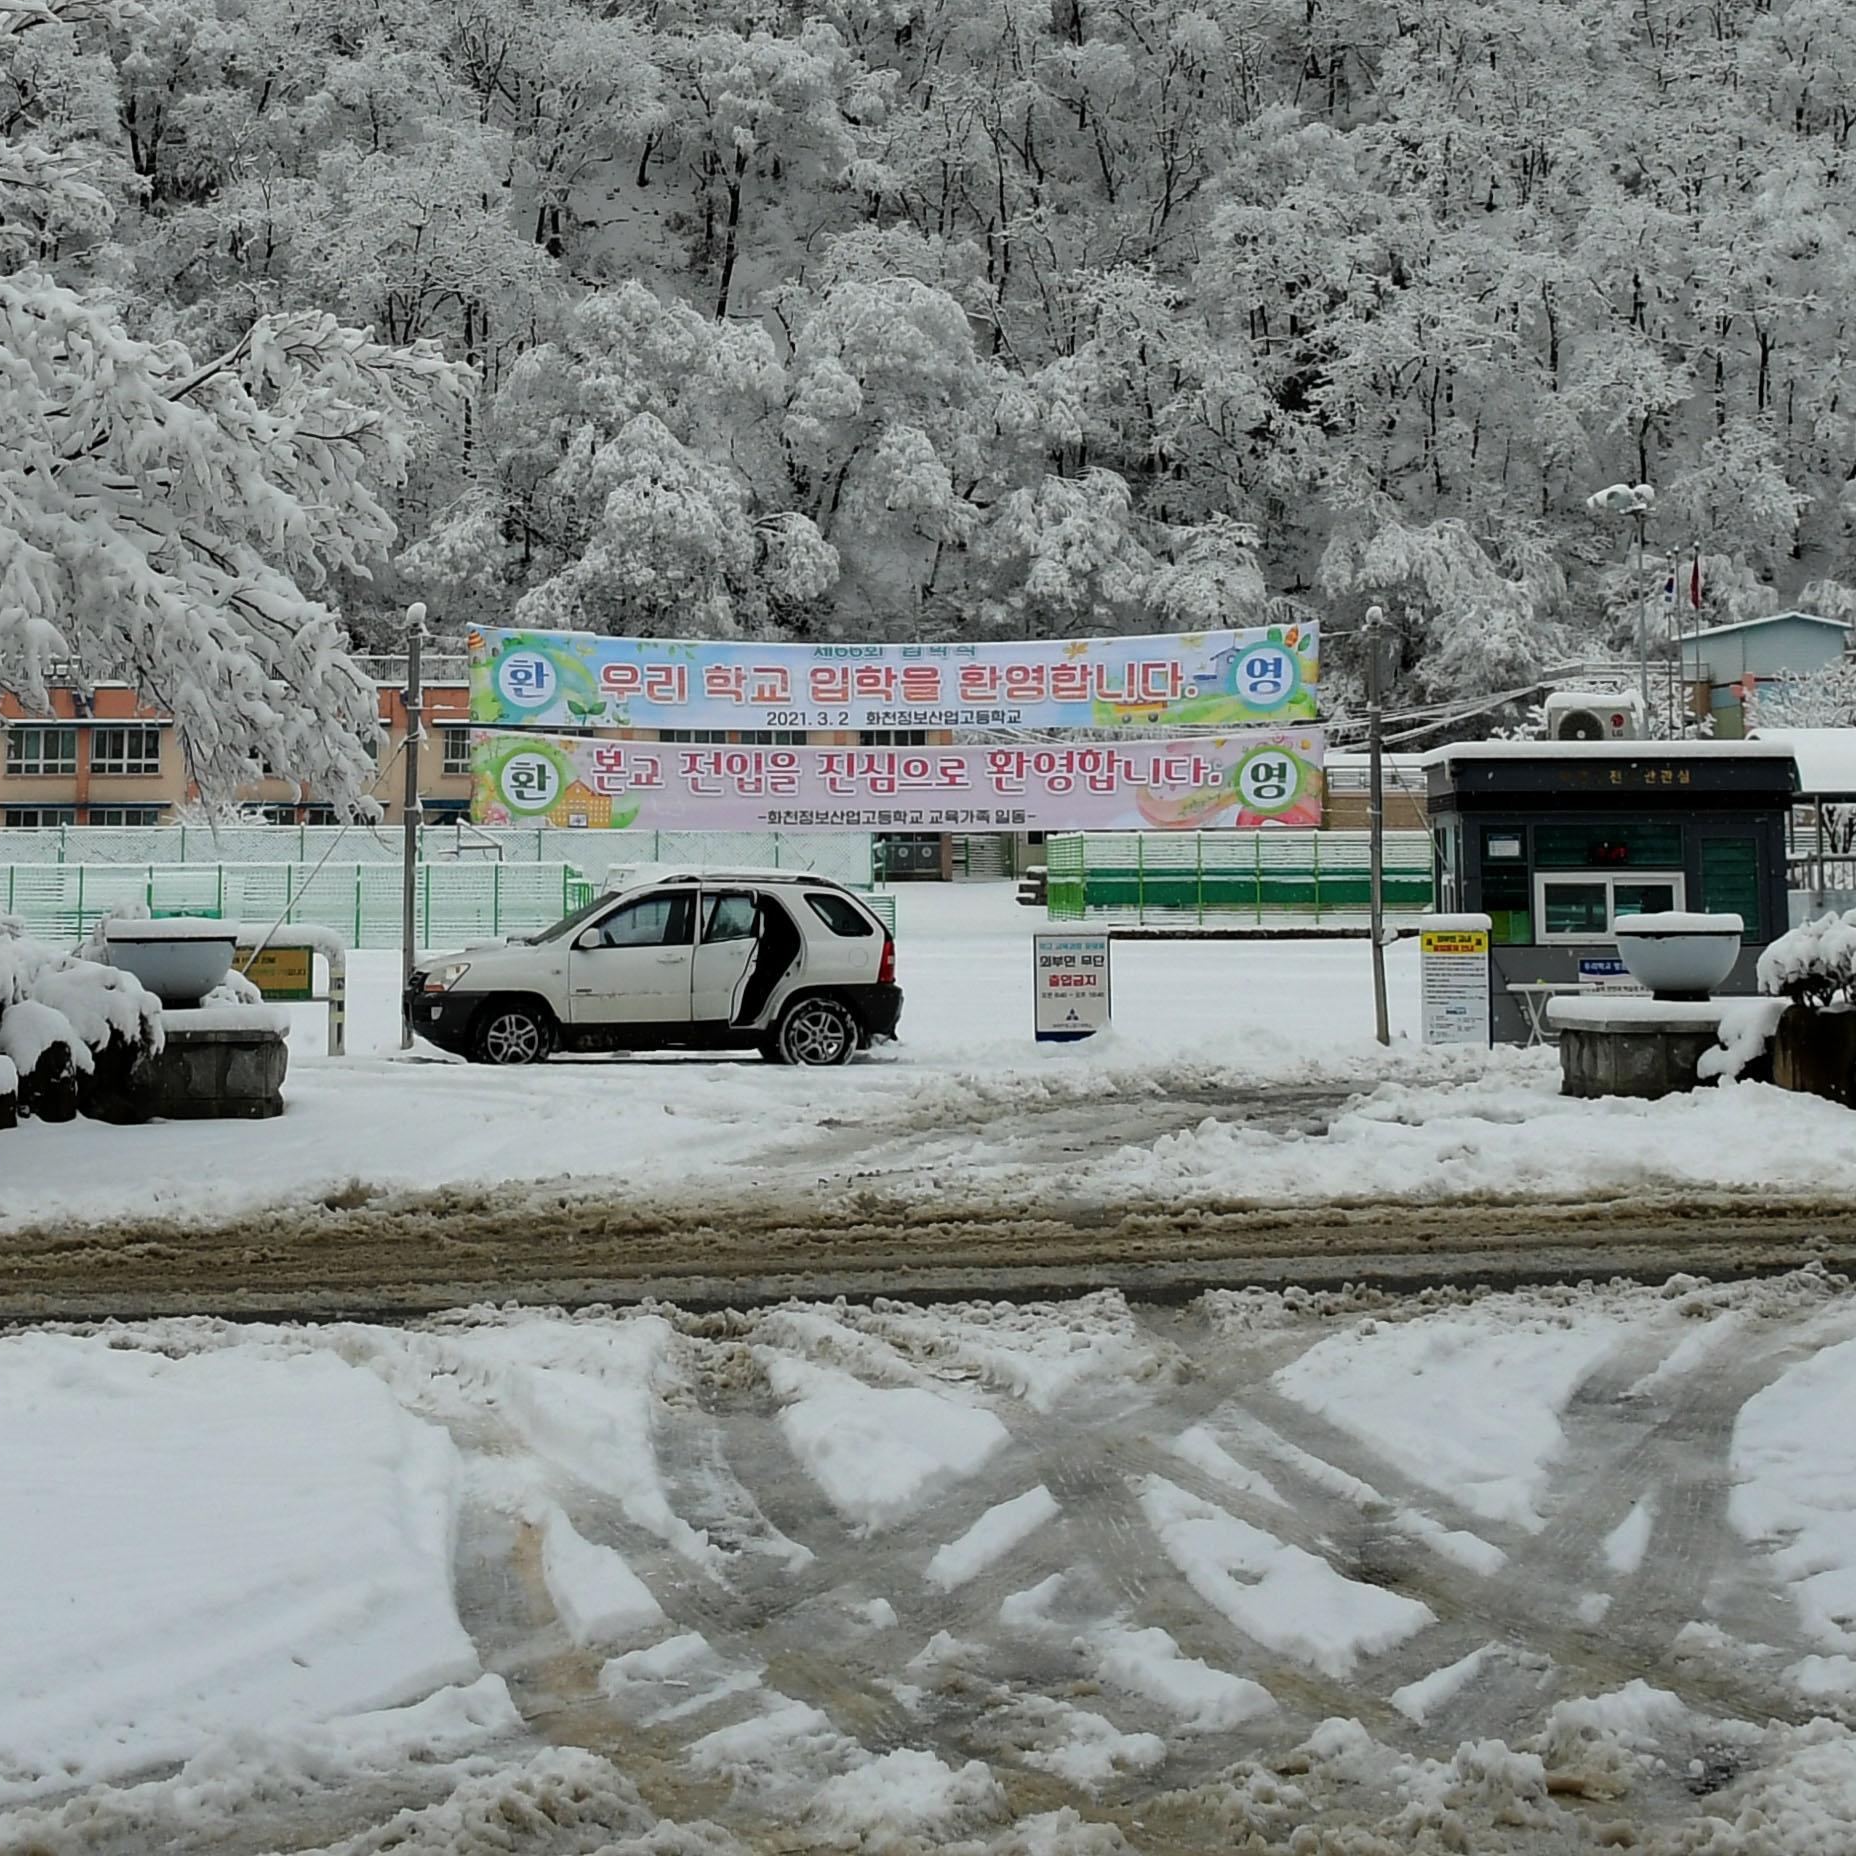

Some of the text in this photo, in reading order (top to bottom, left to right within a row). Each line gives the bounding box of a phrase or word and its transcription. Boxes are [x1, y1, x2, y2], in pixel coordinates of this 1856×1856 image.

[507, 658, 549, 698] 환
[600, 660, 1198, 703] 우리 학교 입학을 환영합니다.
[1246, 656, 1284, 695] 영
[865, 708, 1022, 726] 화천정보산업고등학교
[510, 760, 552, 802] 환
[591, 746, 1225, 796] 본교 전입을 진심으로 환영합니다.
[1250, 760, 1287, 801] 영
[928, 808, 991, 825] 교육가족
[1039, 955, 1105, 968] 외부인 무단
[1048, 974, 1097, 987] 출입금지
